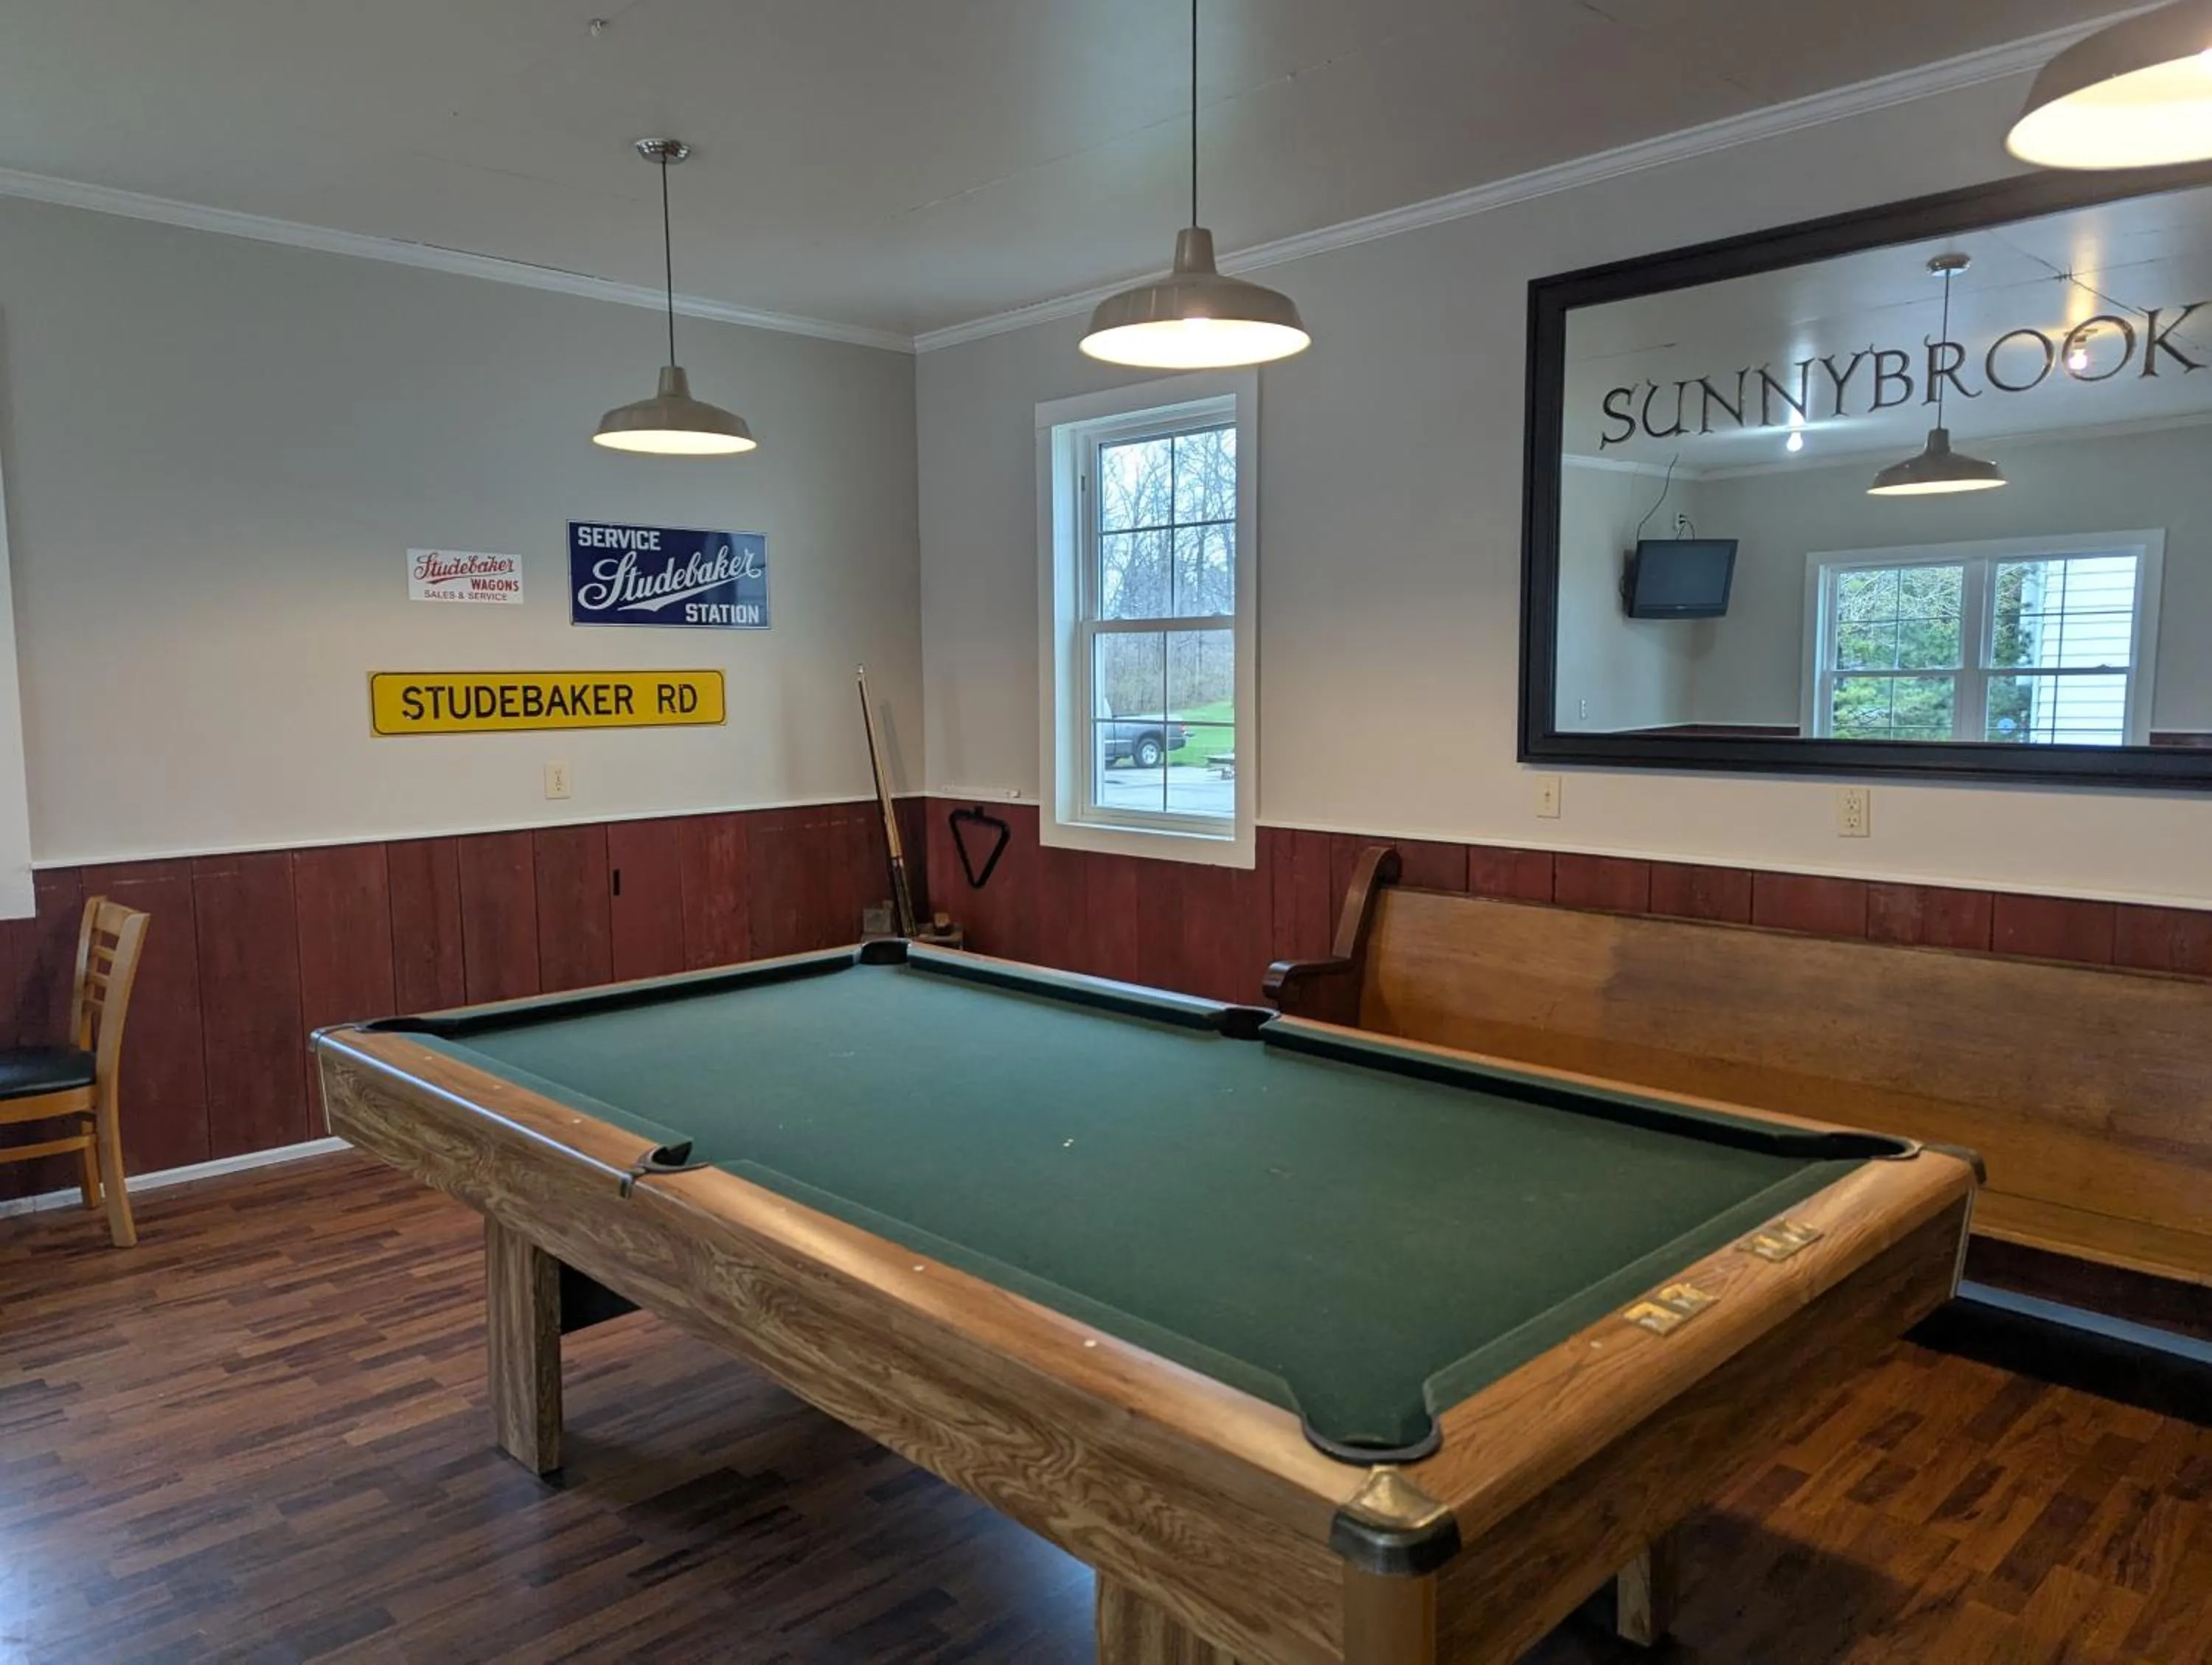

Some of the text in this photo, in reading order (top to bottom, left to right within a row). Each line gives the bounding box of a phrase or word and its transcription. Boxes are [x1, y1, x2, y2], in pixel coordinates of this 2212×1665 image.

[1599, 301, 2212, 450] SUNNYBROOK
[578, 526, 661, 550] SERVICE
[414, 552, 516, 580] Studebaker
[578, 546, 761, 610] Studebaker
[424, 590, 507, 601] SALES & SERVICE
[471, 578, 519, 592] WAGONS
[685, 603, 759, 624] STATION
[401, 683, 698, 720] STUDEBAKER RD
